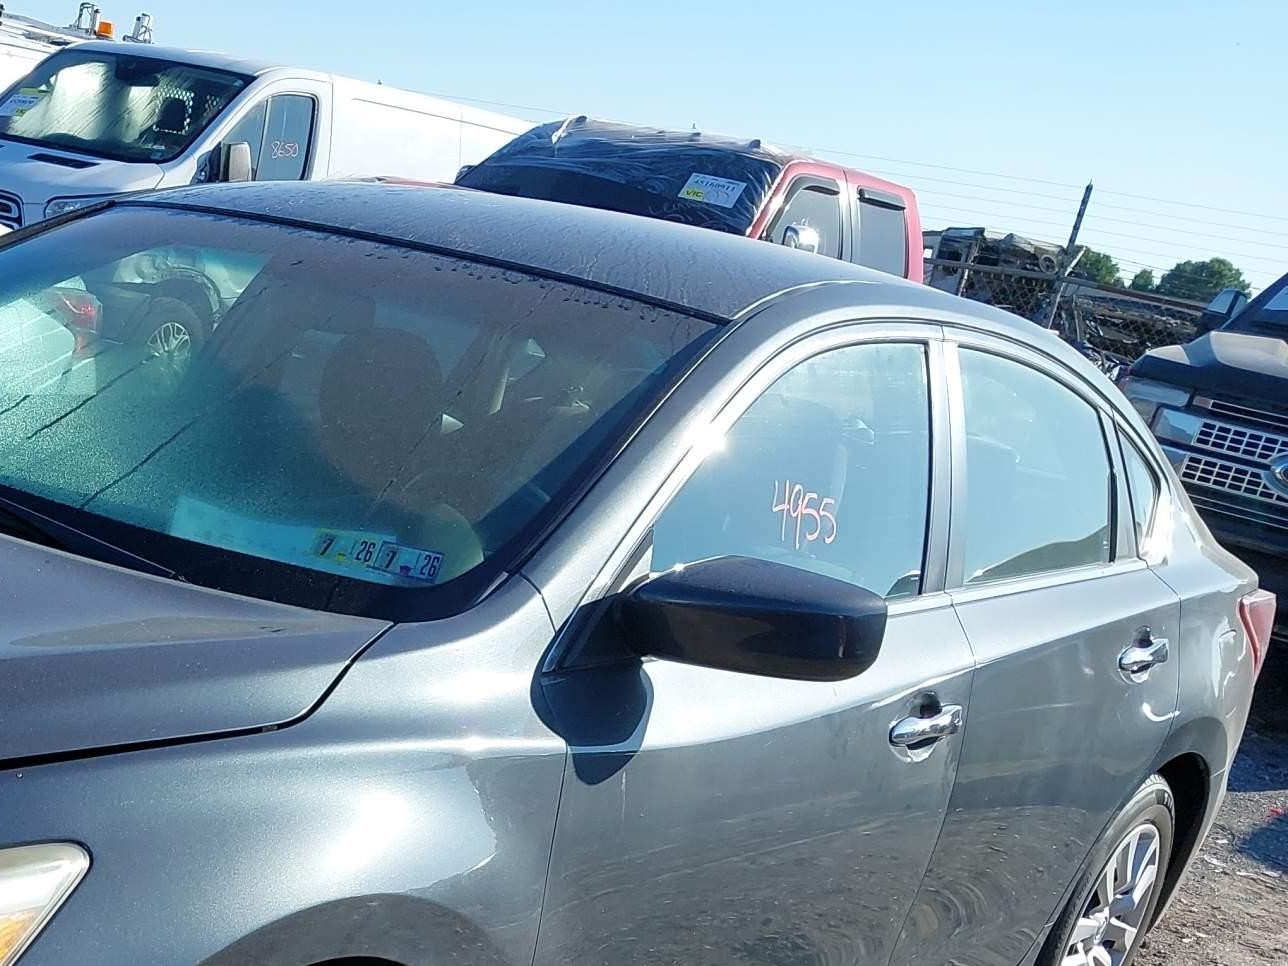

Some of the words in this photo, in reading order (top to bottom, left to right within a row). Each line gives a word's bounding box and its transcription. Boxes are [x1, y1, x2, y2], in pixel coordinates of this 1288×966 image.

[271, 140, 299, 159] 8650
[772, 479, 837, 550] 4955
[320, 535, 335, 556] 7
[355, 540, 376, 563] 26
[385, 549, 399, 569] 7
[419, 554, 440, 578] 26
